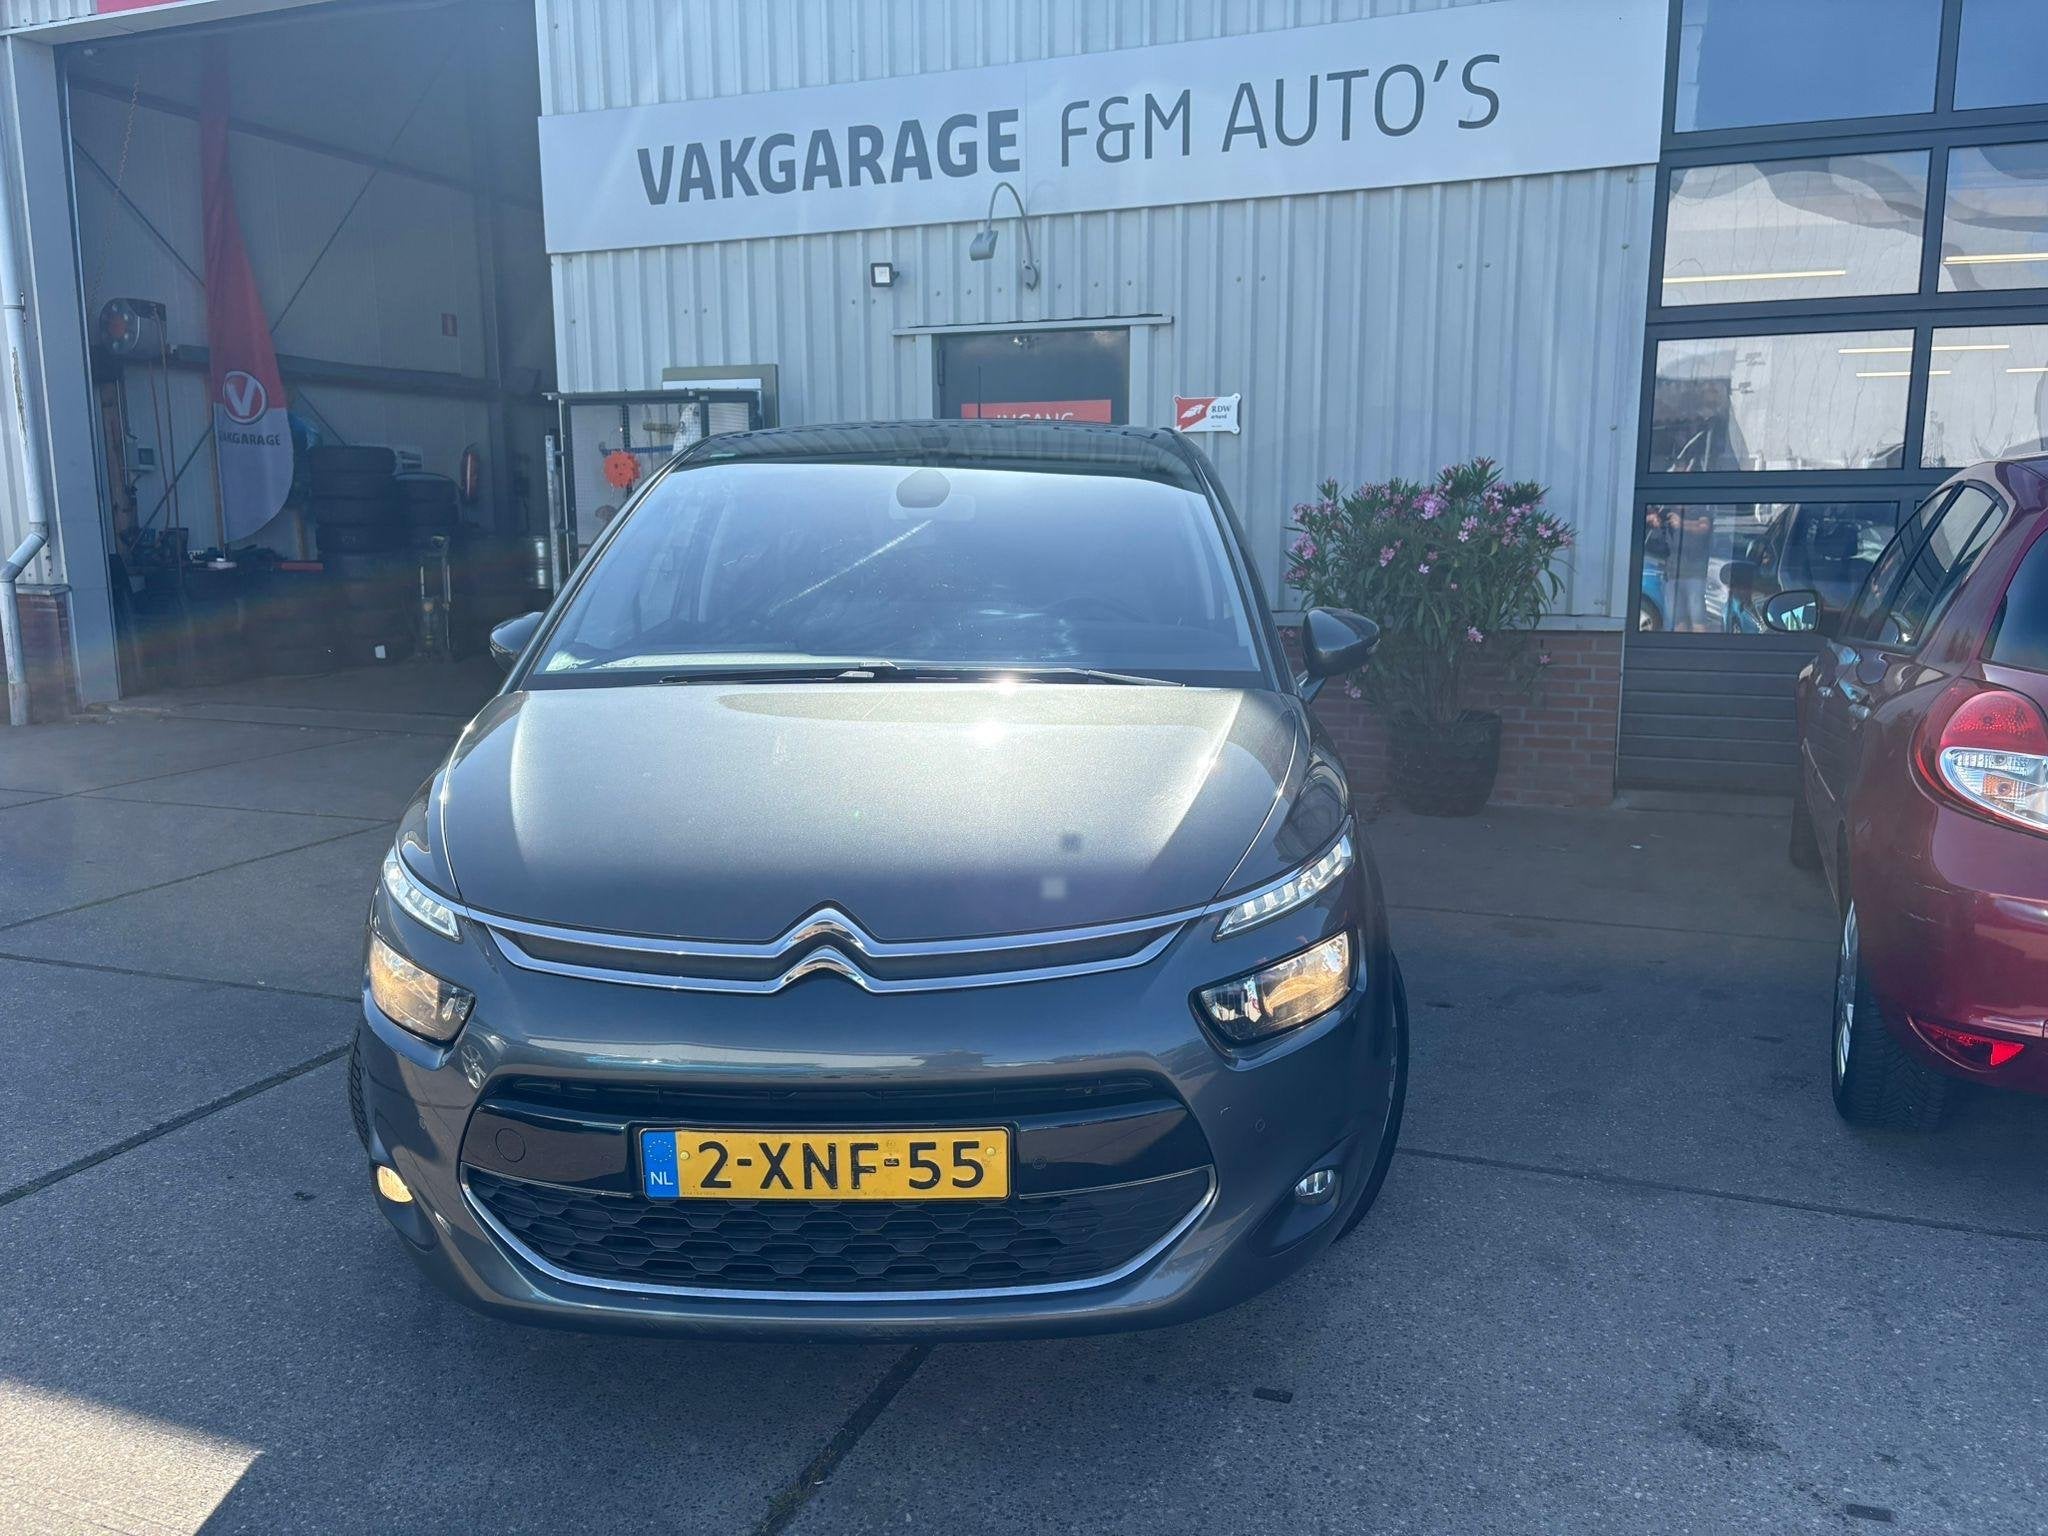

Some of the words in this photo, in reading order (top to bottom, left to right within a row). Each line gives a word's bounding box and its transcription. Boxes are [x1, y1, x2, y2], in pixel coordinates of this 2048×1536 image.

[637, 109, 1021, 206] VAKGARAGE
[1061, 88, 1191, 168] F&M
[1221, 53, 1501, 153] AUTO'S
[1211, 405, 1232, 413] RDW
[219, 431, 281, 446] KGARAGE
[698, 1140, 984, 1190] 2-XNF-55
[650, 1171, 674, 1186] NL
